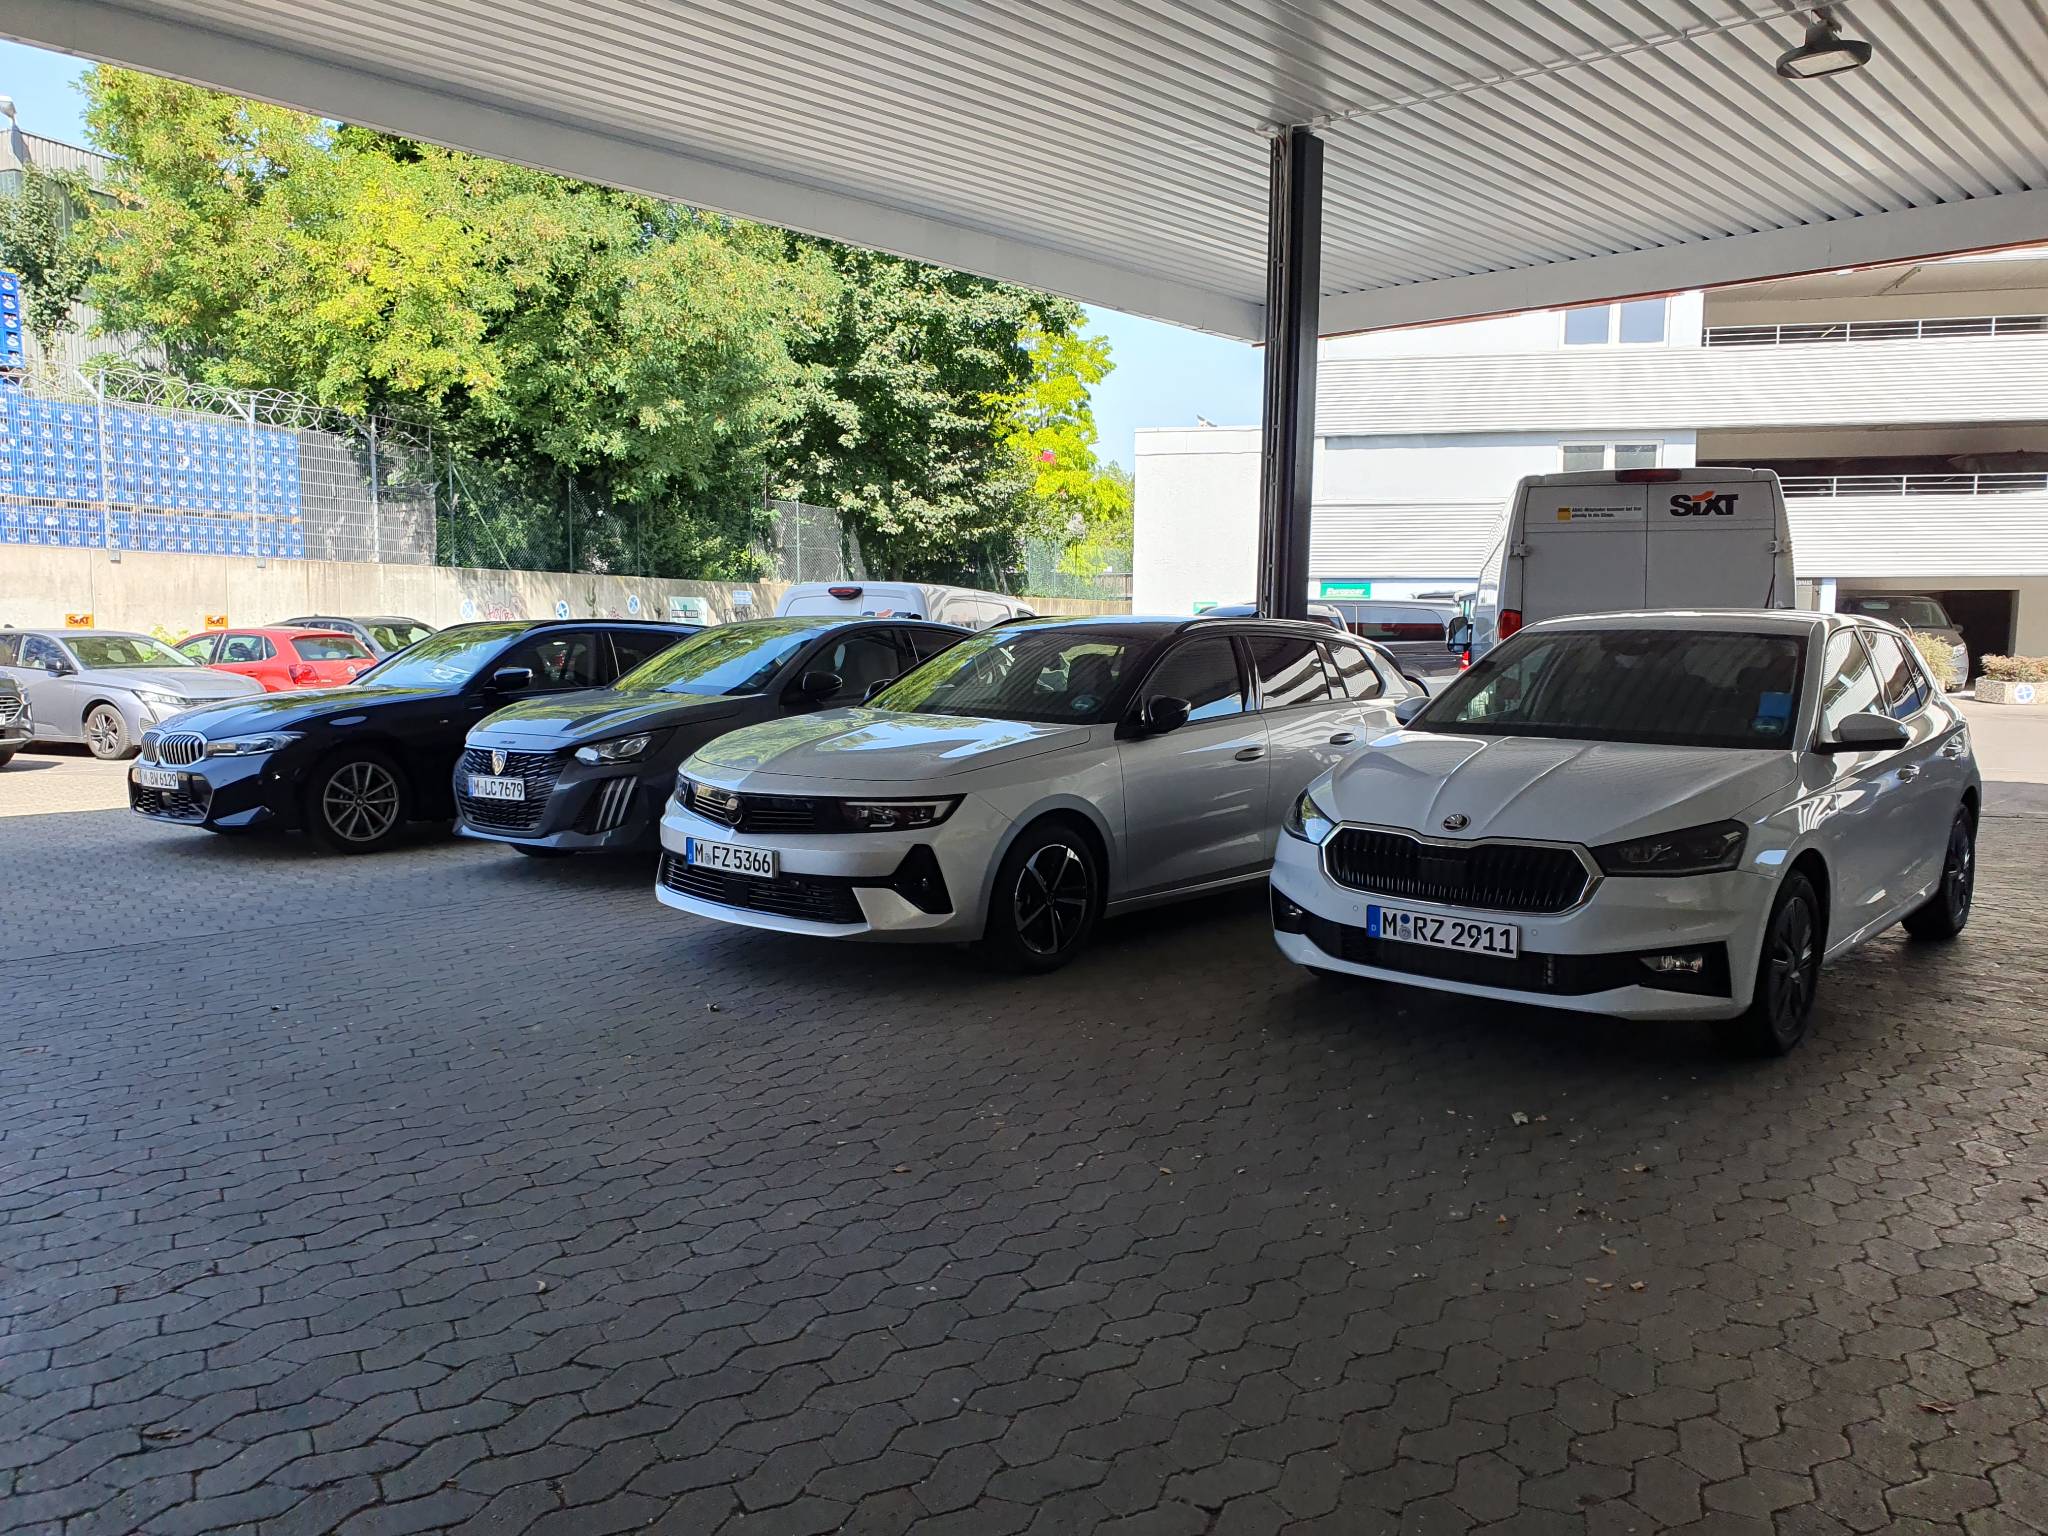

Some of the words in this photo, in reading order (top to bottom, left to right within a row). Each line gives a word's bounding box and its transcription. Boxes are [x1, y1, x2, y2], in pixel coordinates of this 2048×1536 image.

[485, 780, 497, 796] LC
[498, 781, 523, 798] 7679
[695, 842, 704, 863] M
[713, 846, 731, 868] FZ
[733, 849, 771, 873] 5366
[1382, 911, 1398, 936] M
[1413, 916, 1445, 944] RZ
[1451, 922, 1514, 954] 2911
